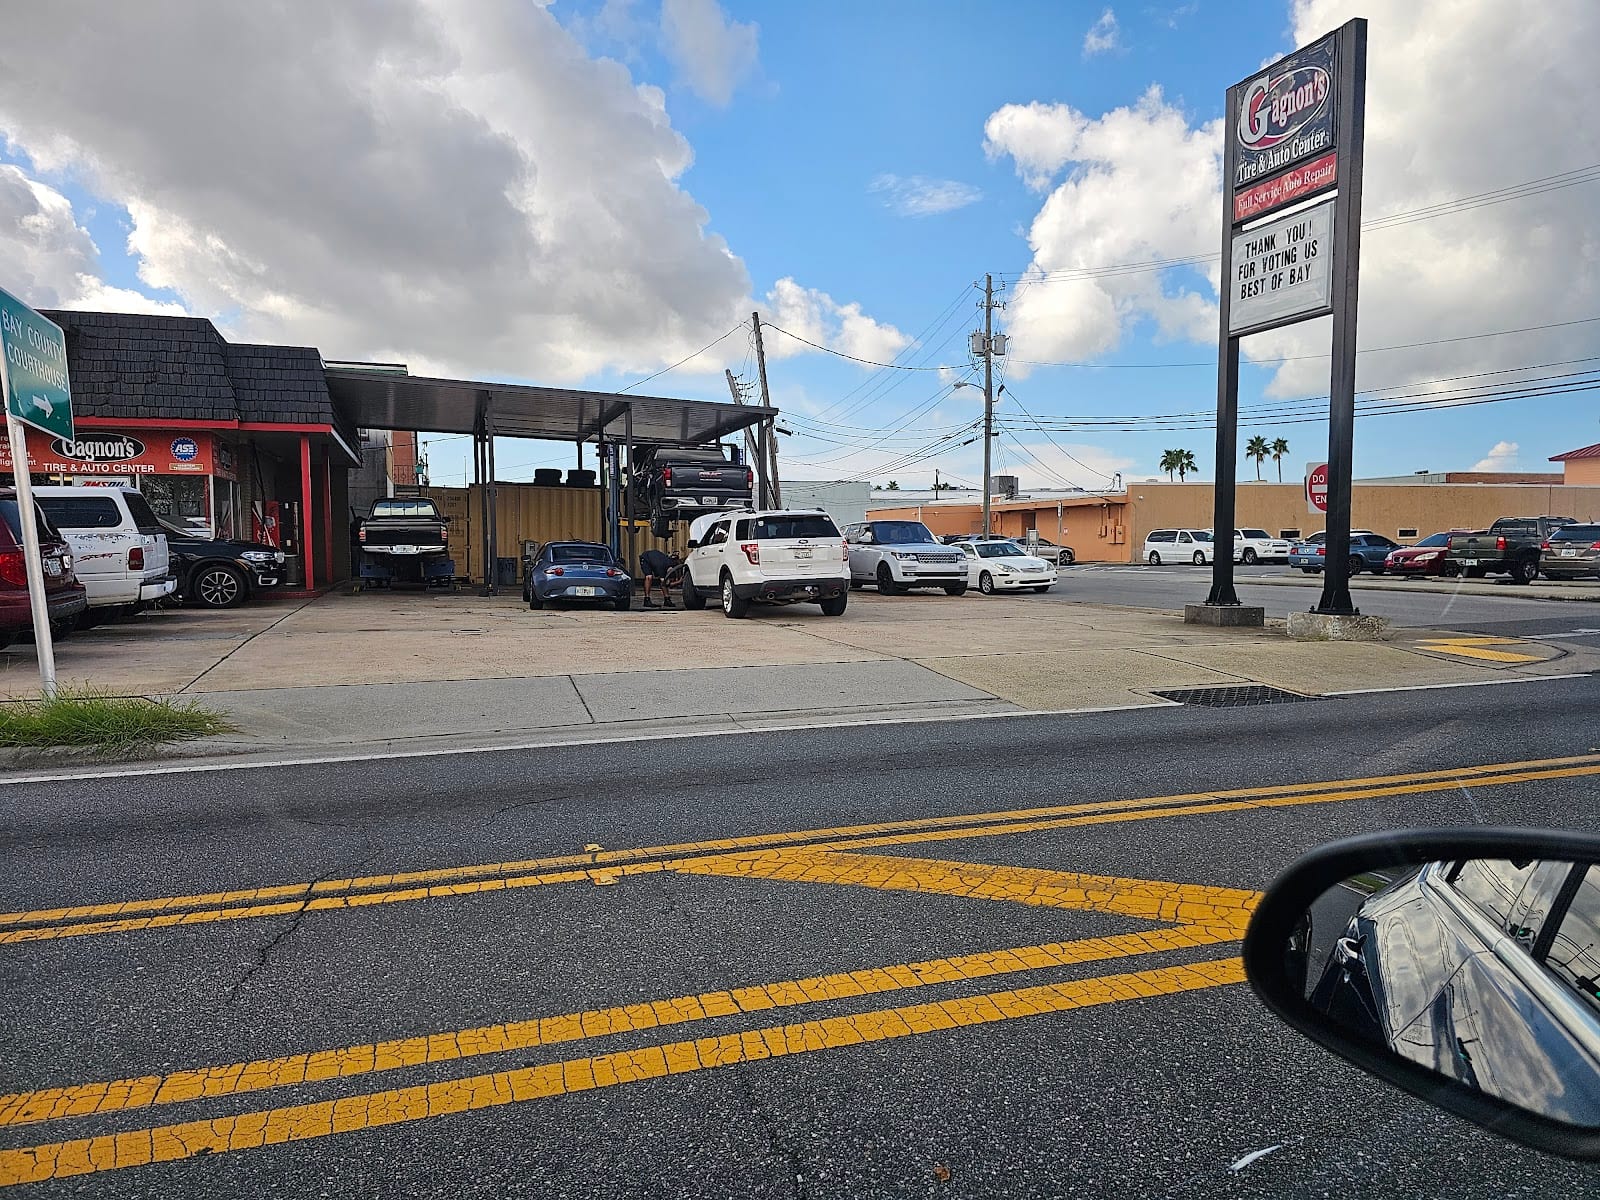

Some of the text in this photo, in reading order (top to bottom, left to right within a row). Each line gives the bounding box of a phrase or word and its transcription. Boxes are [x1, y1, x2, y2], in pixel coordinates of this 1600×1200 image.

[1242, 72, 1326, 143] Gagnon's
[1239, 130, 1325, 182] Tire & Auto Center
[1238, 163, 1333, 211] Full Service Auto Repair
[1238, 240, 1318, 280] FOR VOTING US
[1245, 234, 1276, 259] THANK
[1241, 263, 1311, 300] BEST OF BAY
[2, 308, 62, 362] BAY COUNTY
[7, 342, 67, 393] COURTHOUSE
[61, 437, 135, 461] Gagnon's
[175, 444, 194, 452] ASE
[43, 463, 67, 471] TIRE
[80, 463, 109, 472] AUTO
[113, 464, 155, 472] CENTER
[1312, 474, 1325, 483] DO
[1315, 495, 1327, 504] EN
